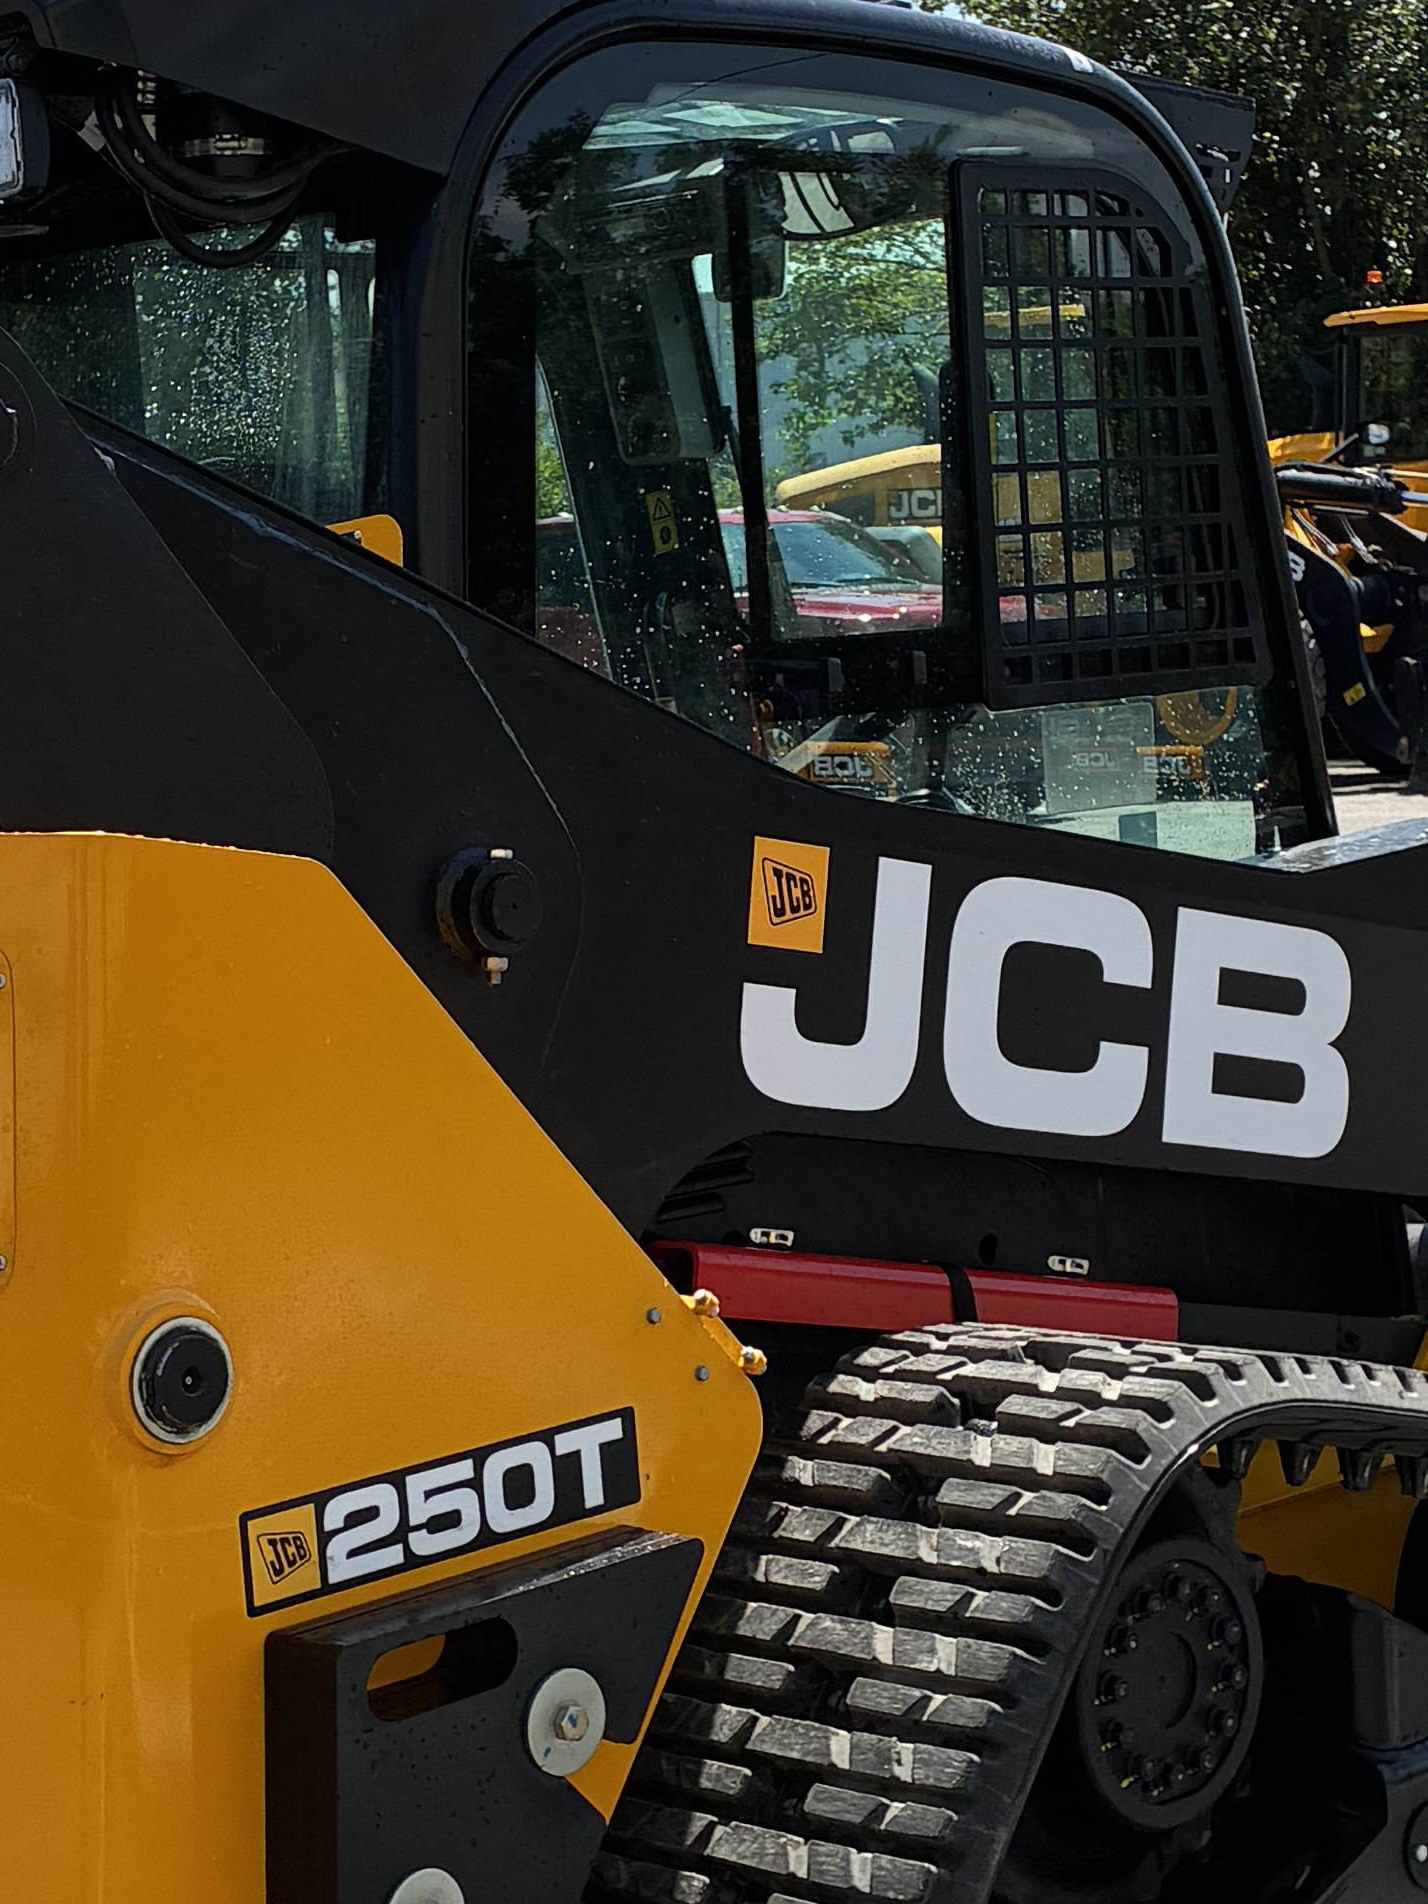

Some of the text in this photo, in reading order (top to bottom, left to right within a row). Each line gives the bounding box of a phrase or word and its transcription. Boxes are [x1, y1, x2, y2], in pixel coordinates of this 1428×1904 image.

[889, 489, 942, 518] JC
[771, 867, 814, 919] JCB
[740, 856, 1352, 1159] JCB
[323, 1417, 624, 1586] 250T
[268, 1533, 309, 1579] JCB
